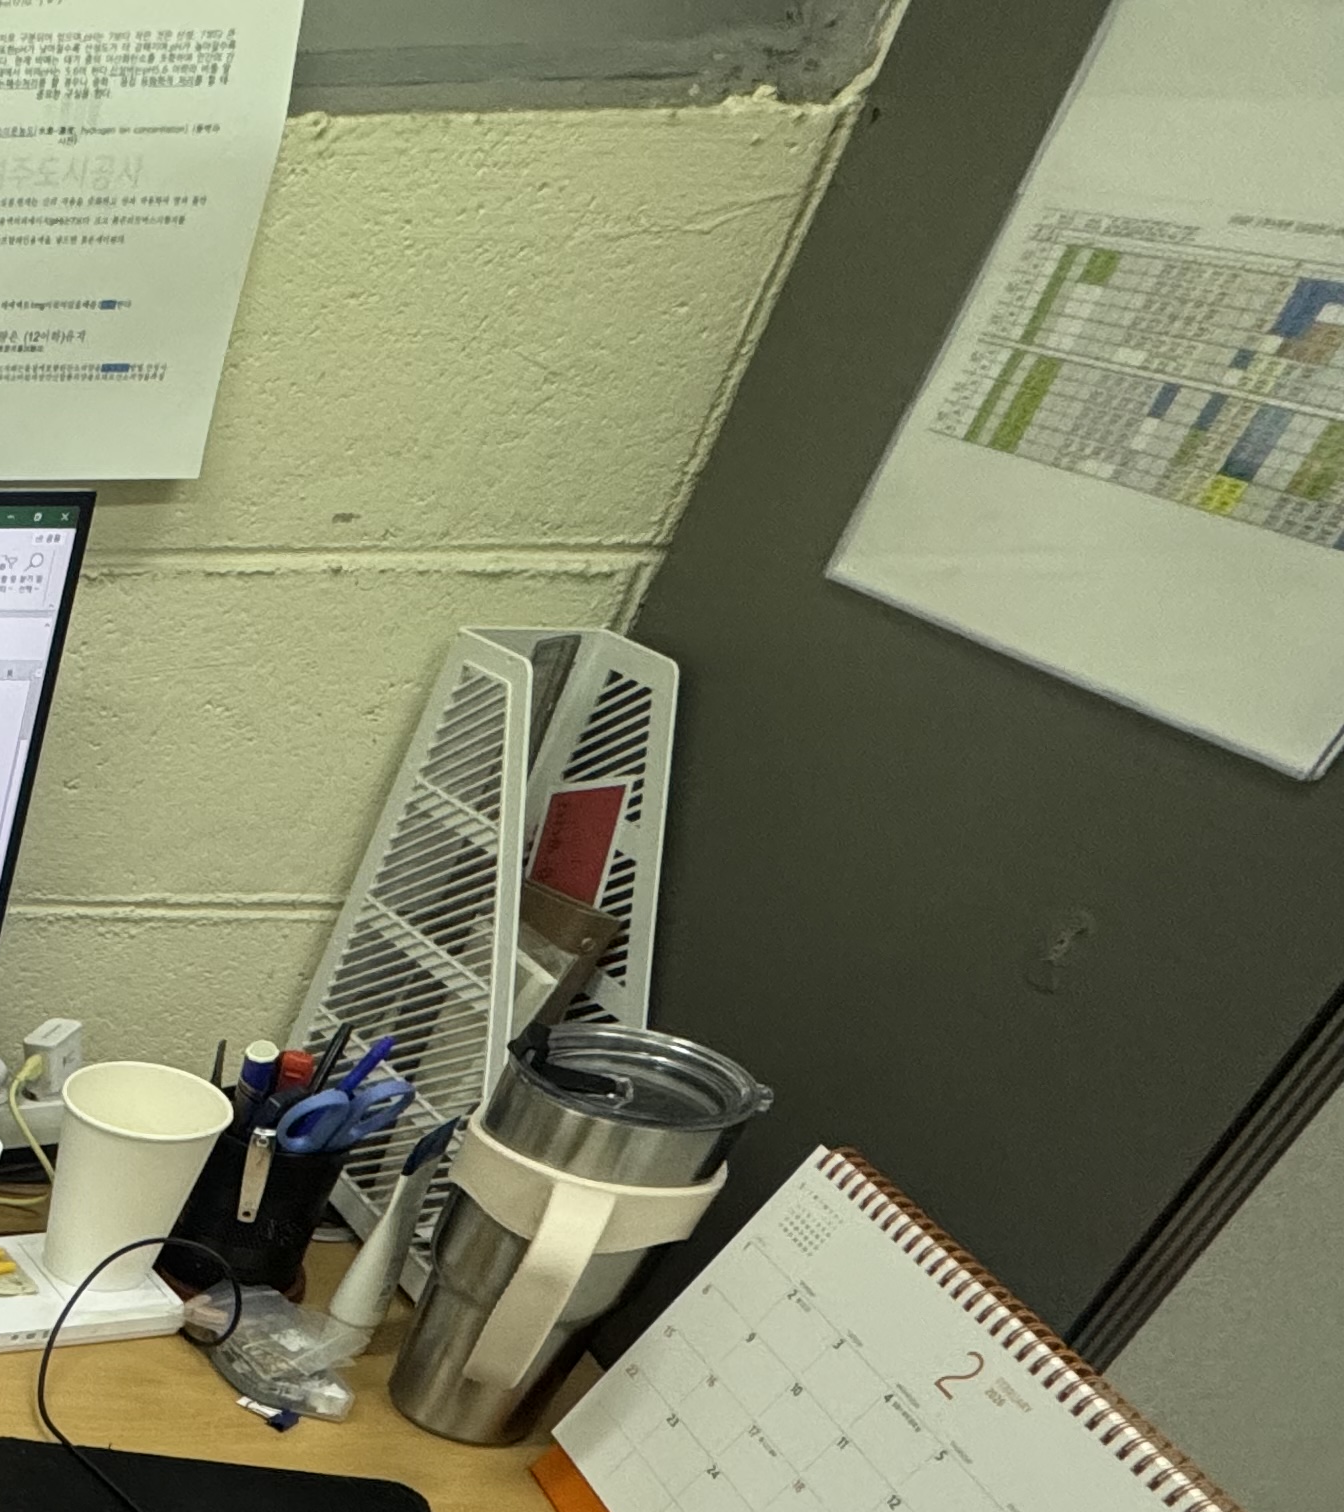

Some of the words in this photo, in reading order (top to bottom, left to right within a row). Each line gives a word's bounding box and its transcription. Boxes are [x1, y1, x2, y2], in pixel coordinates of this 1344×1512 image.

[787, 1289, 798, 1300] 2
[664, 1325, 676, 1338] 15
[746, 1332, 757, 1343] 9
[832, 1338, 845, 1350] 3
[625, 1364, 638, 1378] 22
[934, 1351, 984, 1400] 2
[790, 1382, 803, 1397] 10
[884, 1393, 894, 1404] 4
[666, 1413, 680, 1428] 23
[748, 1425, 761, 1438] 17
[837, 1436, 850, 1450] 11
[934, 1449, 948, 1461] 5
[707, 1465, 720, 1479] 24
[793, 1480, 805, 1493] 18
[887, 1494, 902, 1510] 12
